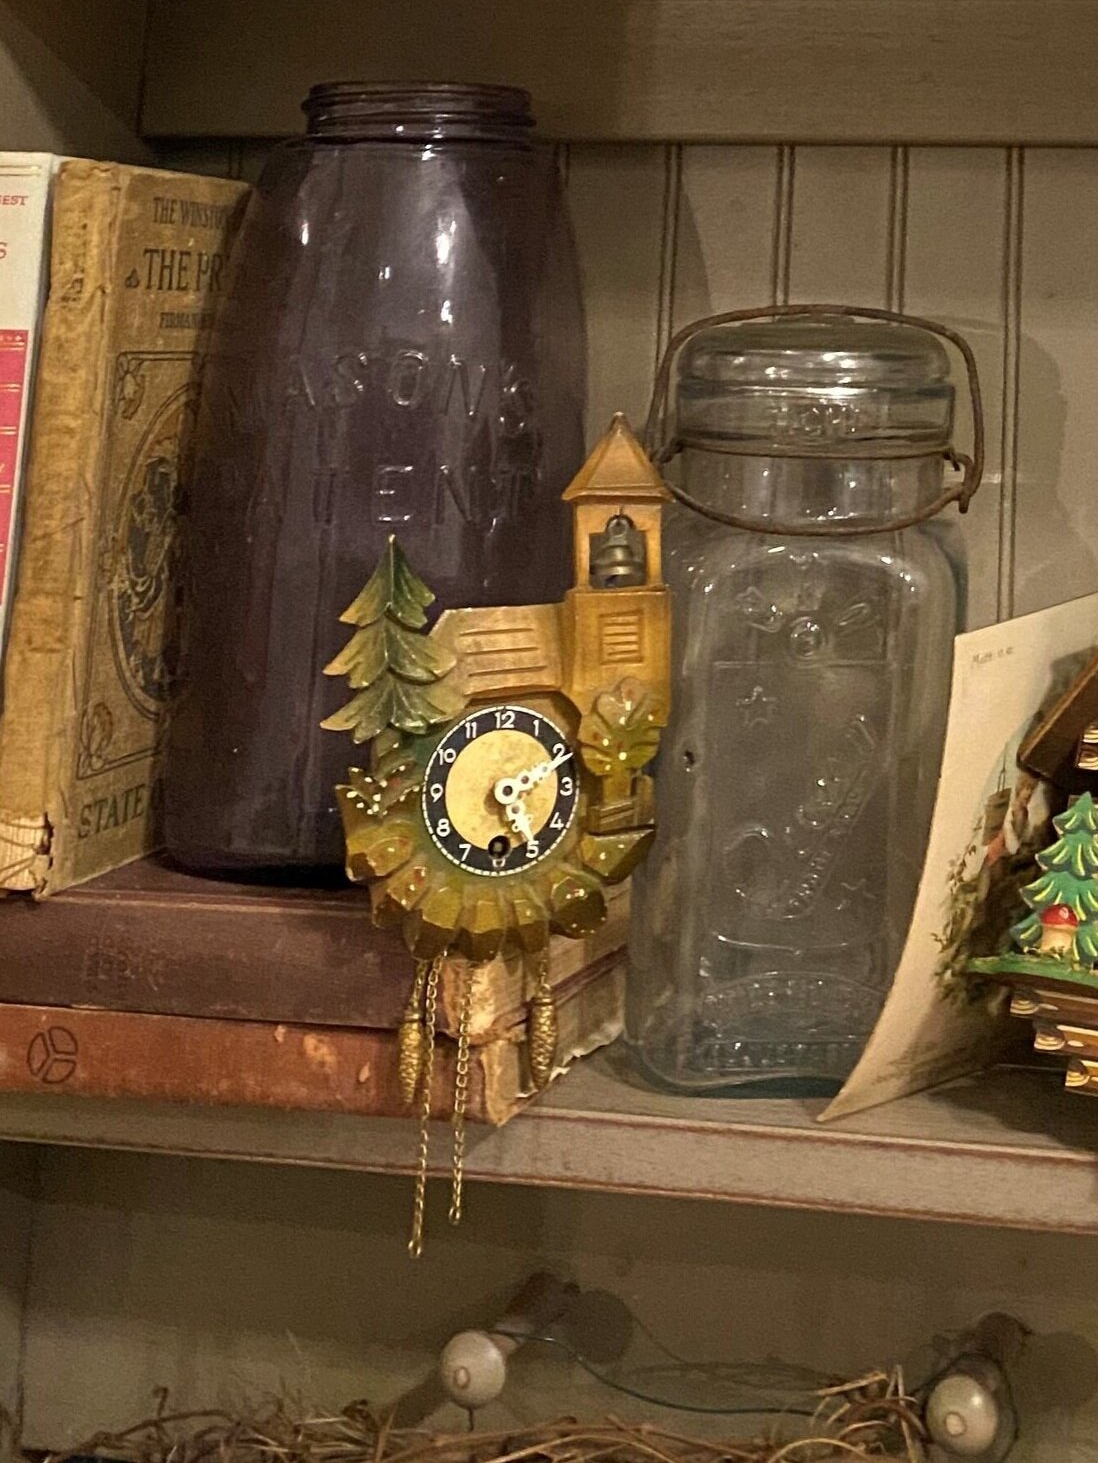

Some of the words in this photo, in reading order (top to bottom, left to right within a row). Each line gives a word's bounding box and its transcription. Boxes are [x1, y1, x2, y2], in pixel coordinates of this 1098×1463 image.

[0, 195, 29, 206] EST
[153, 197, 177, 224] THE
[143, 248, 191, 291] THE
[196, 251, 231, 292] PR
[494, 711, 516, 729] 12
[532, 719, 540, 737] 1
[465, 721, 478, 739] 11
[438, 748, 457, 766] 10
[552, 743, 570, 760] 2
[430, 783, 444, 803] 9
[560, 776, 573, 796] 3
[78, 783, 146, 839] STATE
[436, 818, 451, 837] 8
[550, 812, 564, 830] 4
[458, 844, 472, 862] 7
[525, 840, 540, 859] 5
